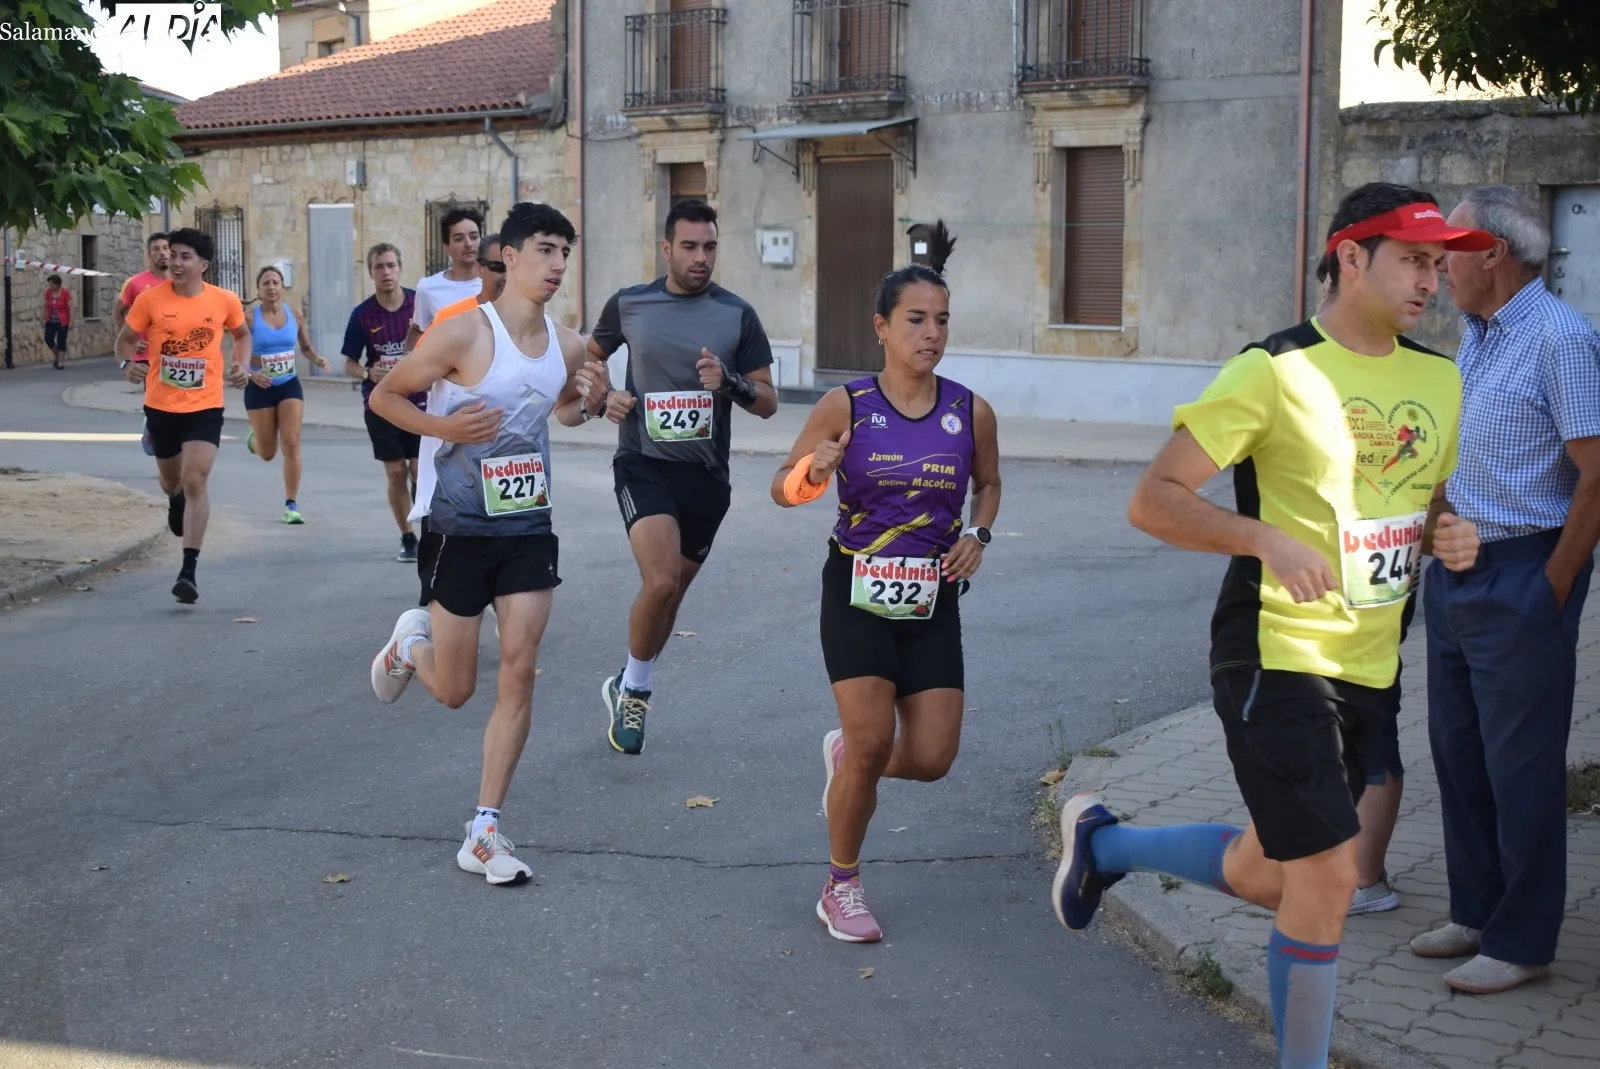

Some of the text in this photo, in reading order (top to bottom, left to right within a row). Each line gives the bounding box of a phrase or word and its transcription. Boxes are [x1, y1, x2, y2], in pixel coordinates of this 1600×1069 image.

[161, 357, 205, 370] bedunia
[262, 352, 295, 364] bedunia
[270, 361, 289, 373] 231
[169, 369, 195, 382] 221
[646, 394, 712, 411] bedunia
[660, 410, 700, 430] 249
[868, 452, 903, 462] Jamón
[483, 458, 543, 479] bedunia
[922, 463, 955, 475] PRIM
[498, 475, 536, 500] 227
[912, 477, 957, 490] Macotera
[855, 559, 938, 582] bedunia
[1368, 546, 1413, 586] 244
[869, 580, 922, 605] 232
